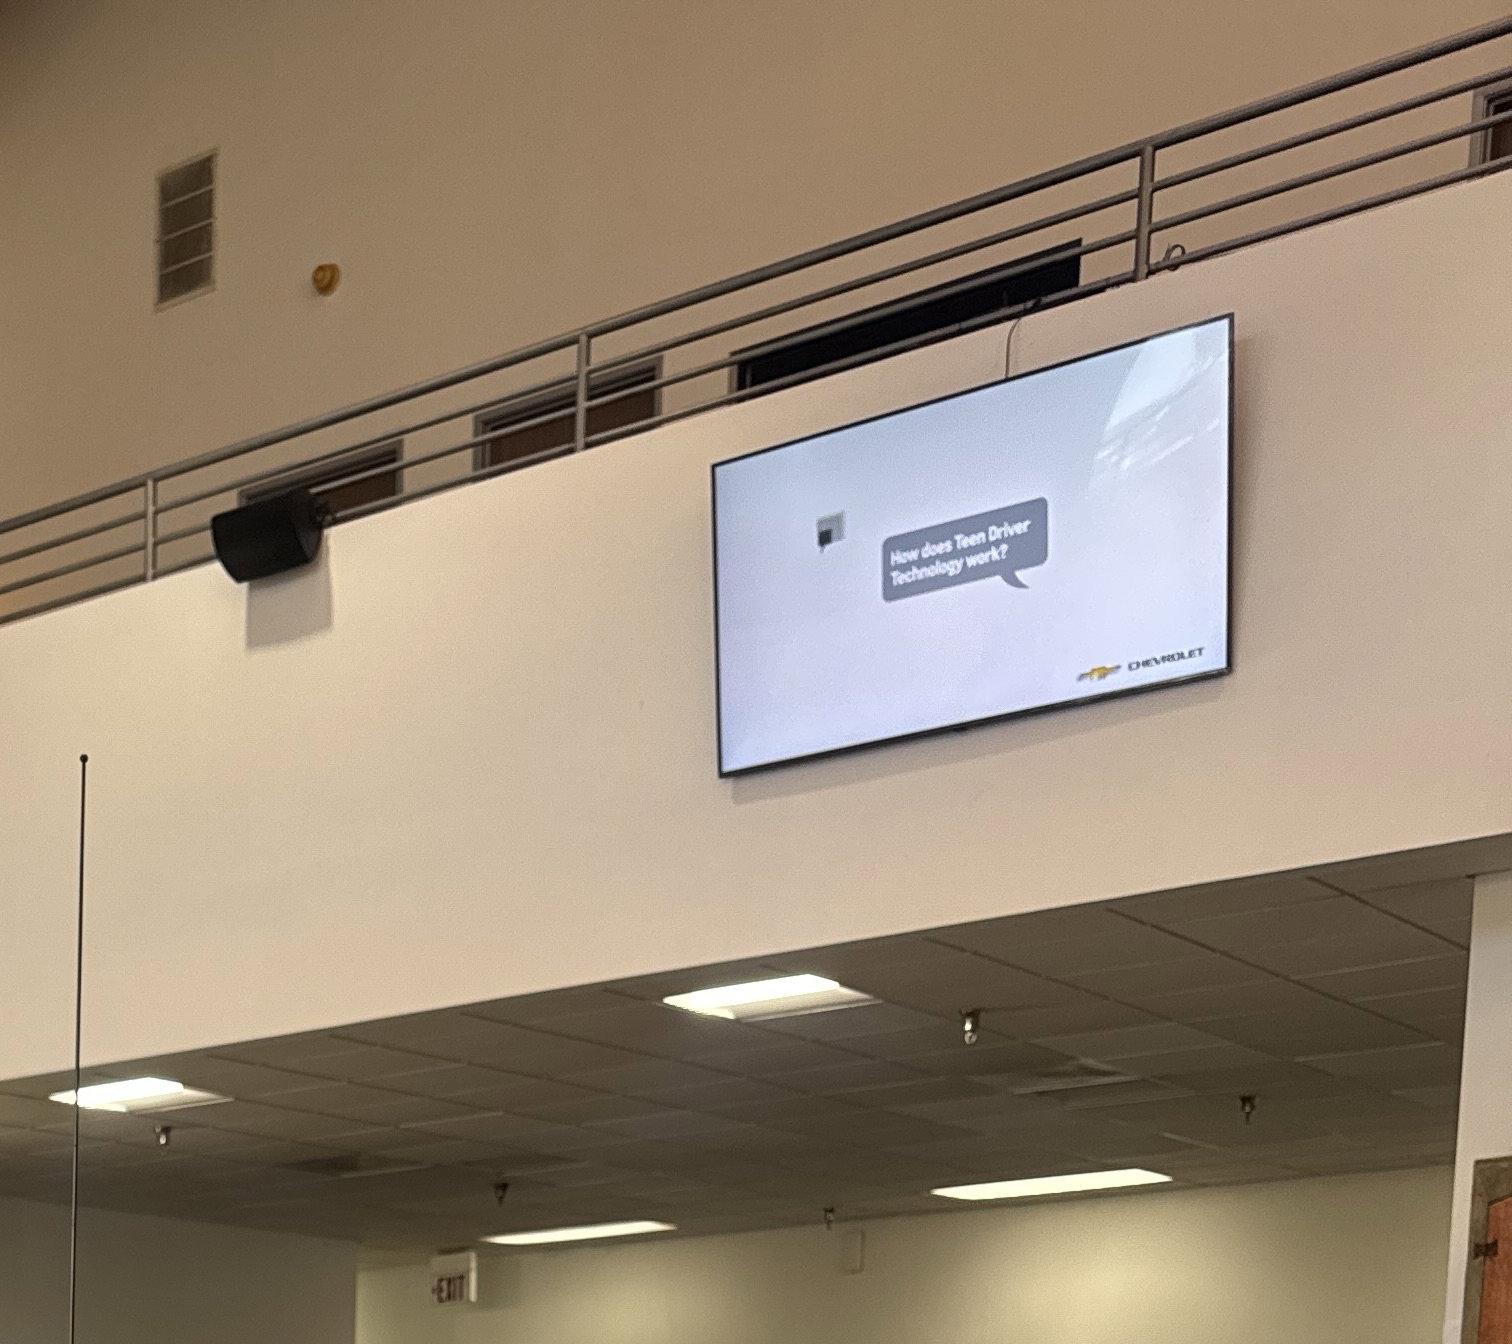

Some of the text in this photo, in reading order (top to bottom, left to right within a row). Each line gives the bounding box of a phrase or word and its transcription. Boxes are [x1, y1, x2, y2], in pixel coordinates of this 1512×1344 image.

[890, 519, 1031, 566] How does Teen Driver
[890, 543, 1009, 587] Technology work?
[1128, 646, 1205, 671] CHEVROLET
